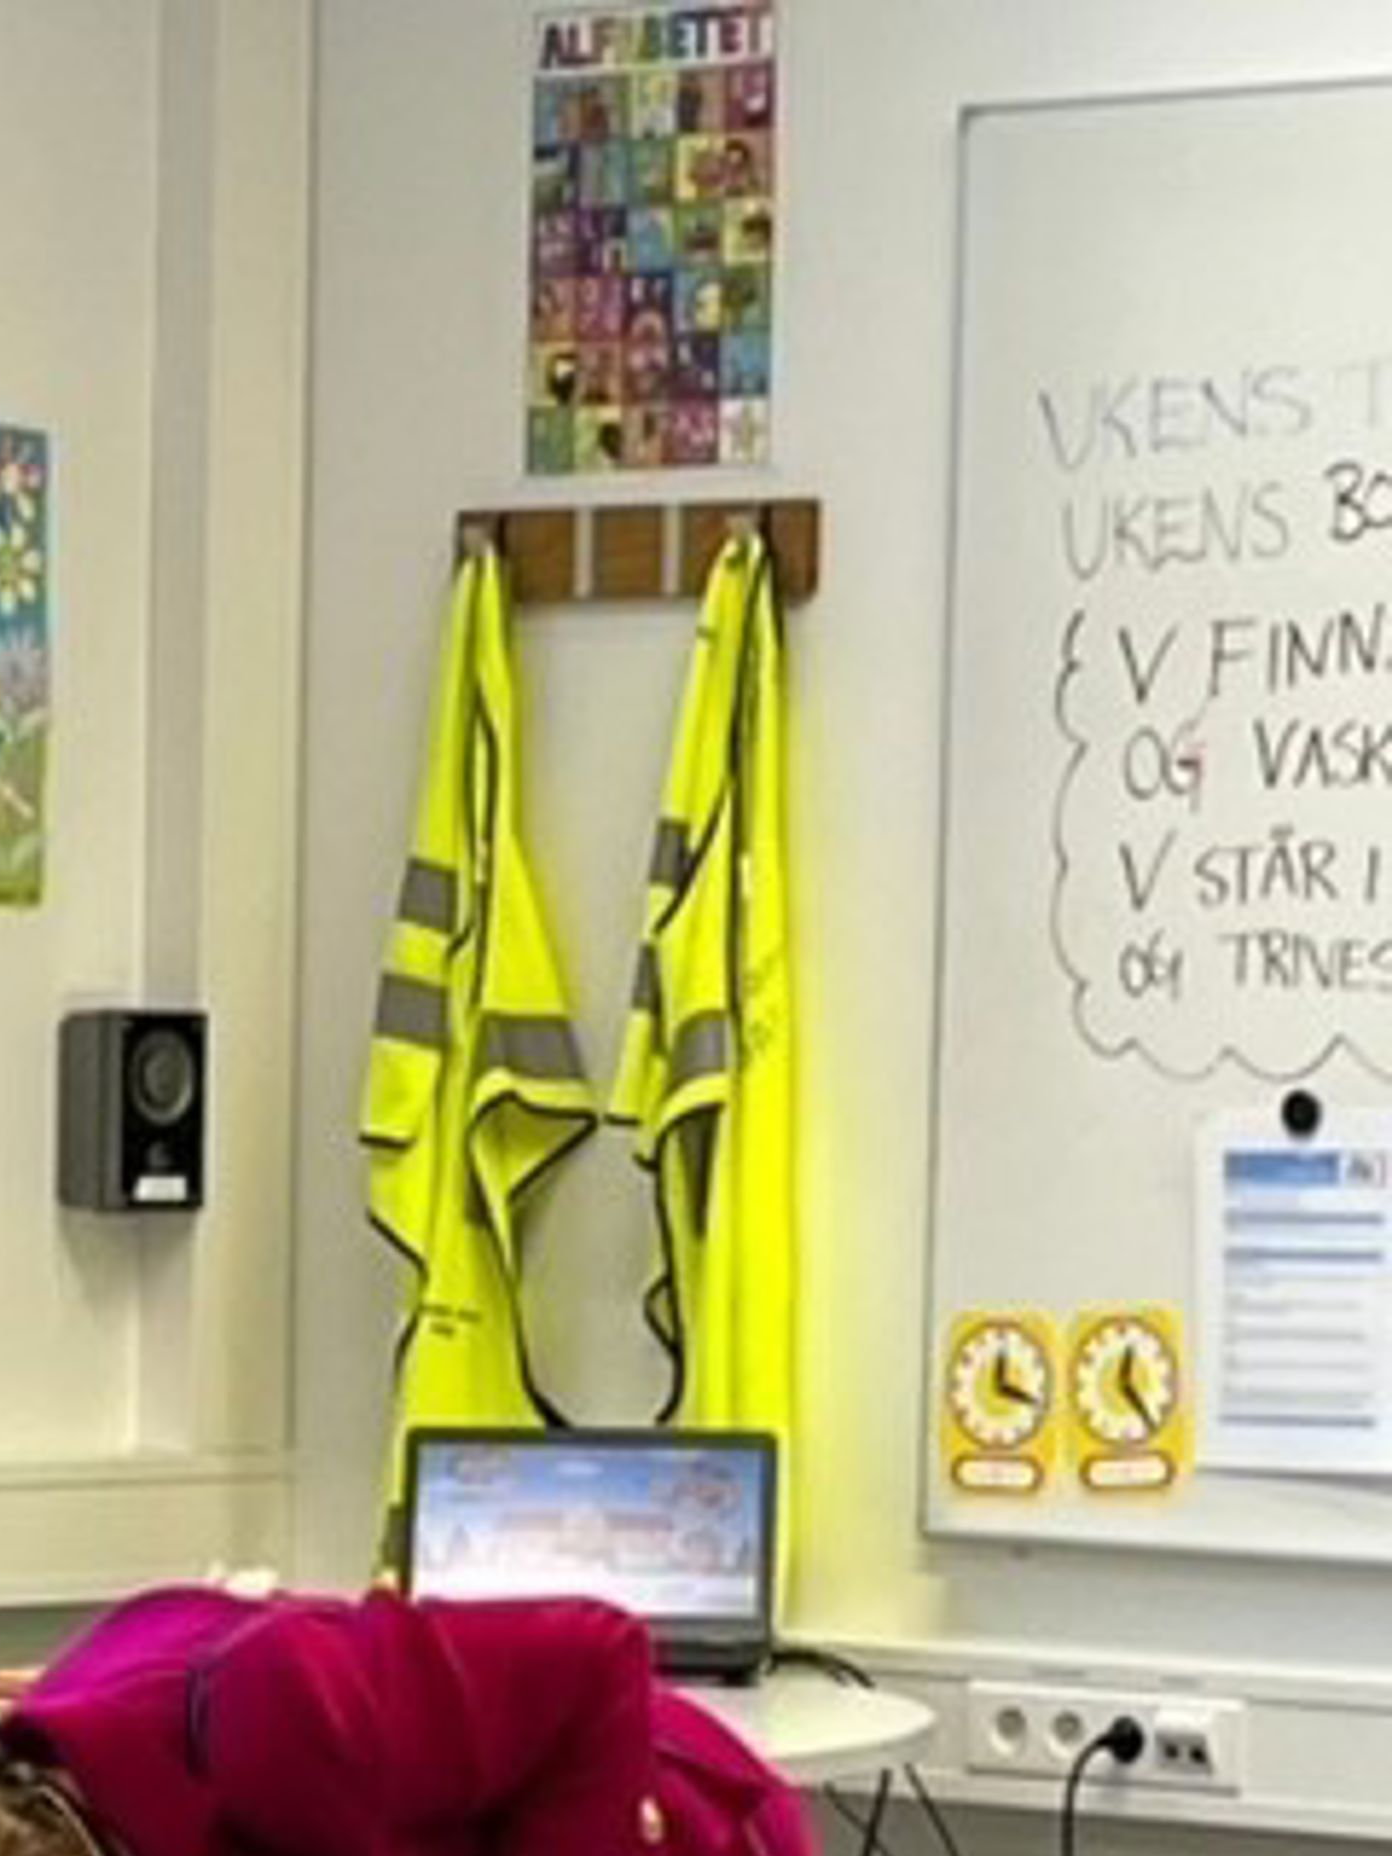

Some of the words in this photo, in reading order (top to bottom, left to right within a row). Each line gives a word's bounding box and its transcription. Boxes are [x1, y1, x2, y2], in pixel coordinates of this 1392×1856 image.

[1038, 366, 1310, 472] UKENS
[1062, 481, 1290, 580] UKENS
[1209, 602, 1392, 698] FINN
[1123, 716, 1206, 814] OG
[1119, 928, 1184, 1001] OG
